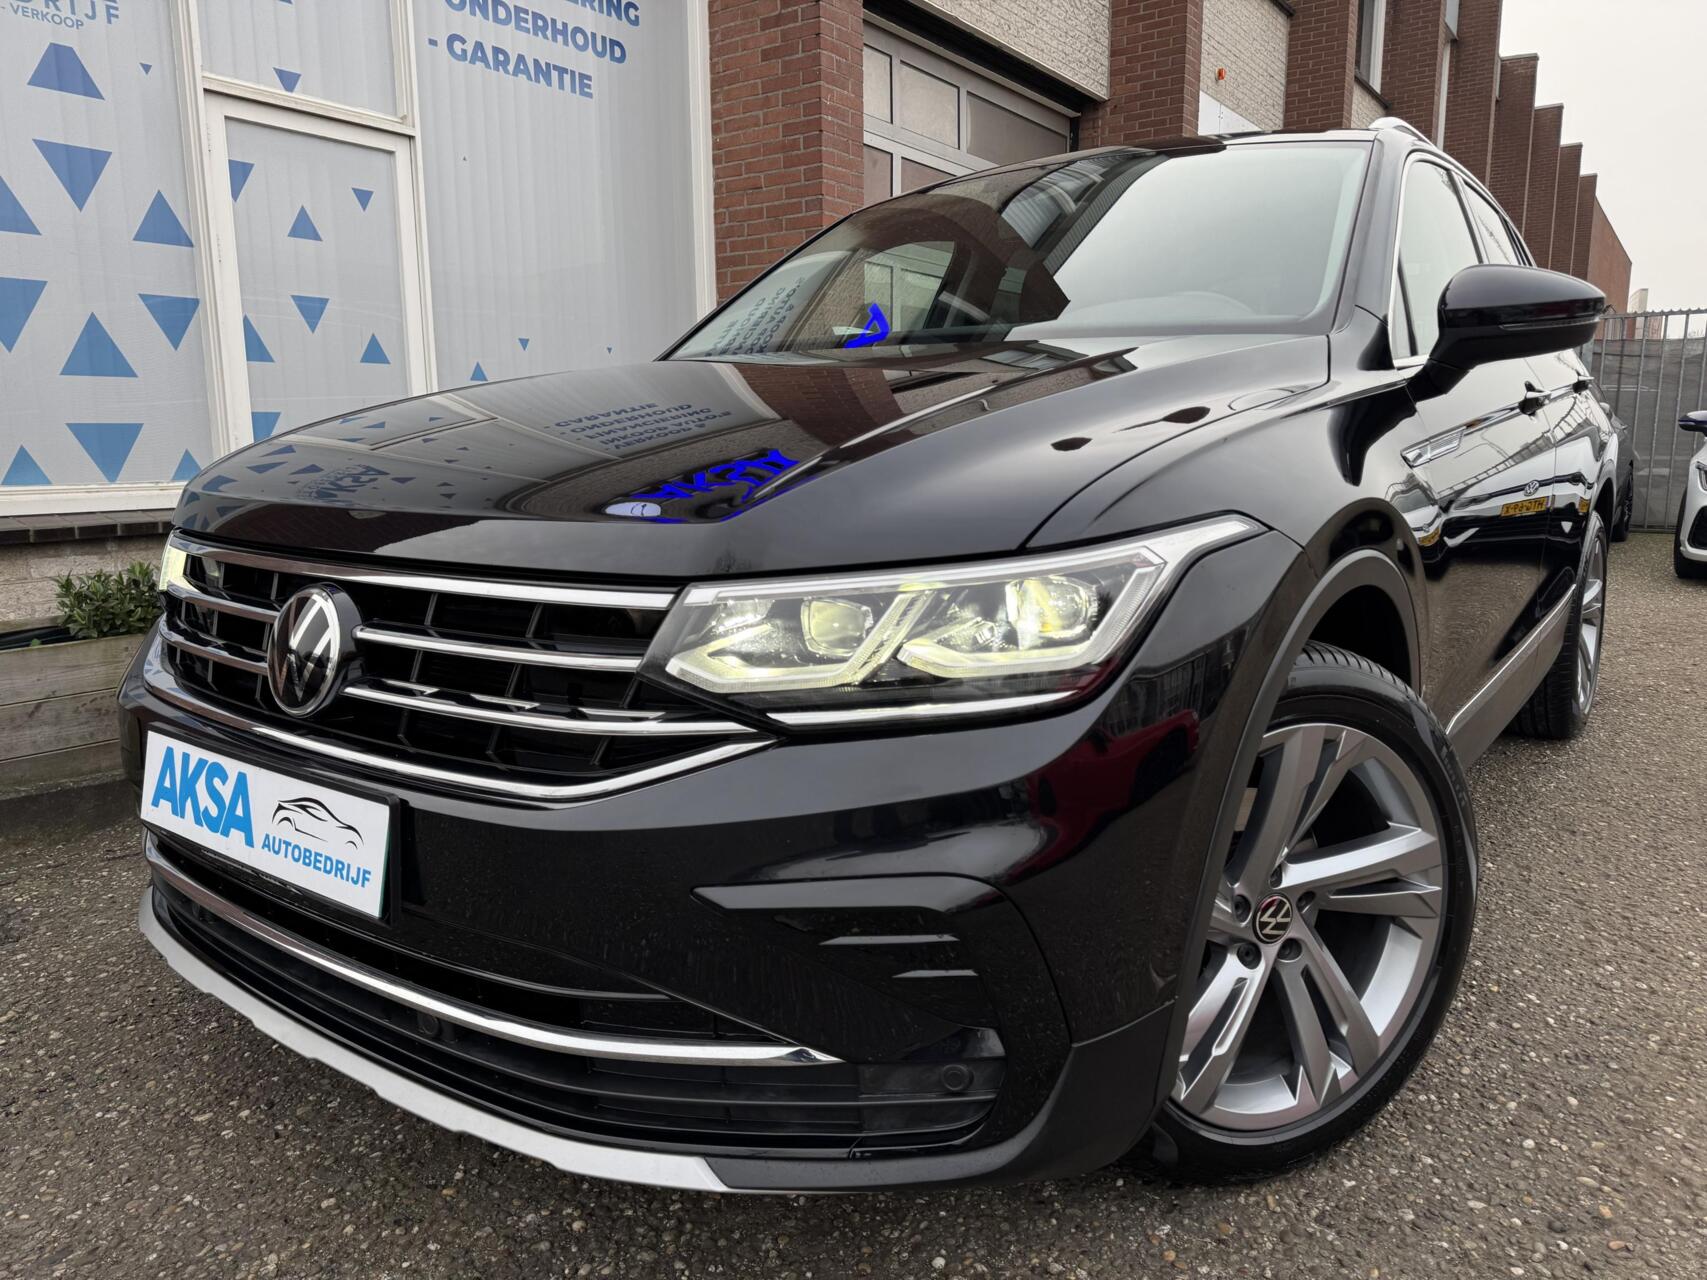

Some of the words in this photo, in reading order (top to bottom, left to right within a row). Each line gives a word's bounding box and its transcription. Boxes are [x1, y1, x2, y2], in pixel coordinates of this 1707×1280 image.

[9, 2, 84, 30] VERKOOP
[566, 0, 640, 27] ING
[446, 33, 594, 99] GARANTIE
[151, 745, 255, 849] AKSA
[262, 833, 372, 889] AUTOBEDRIJF
